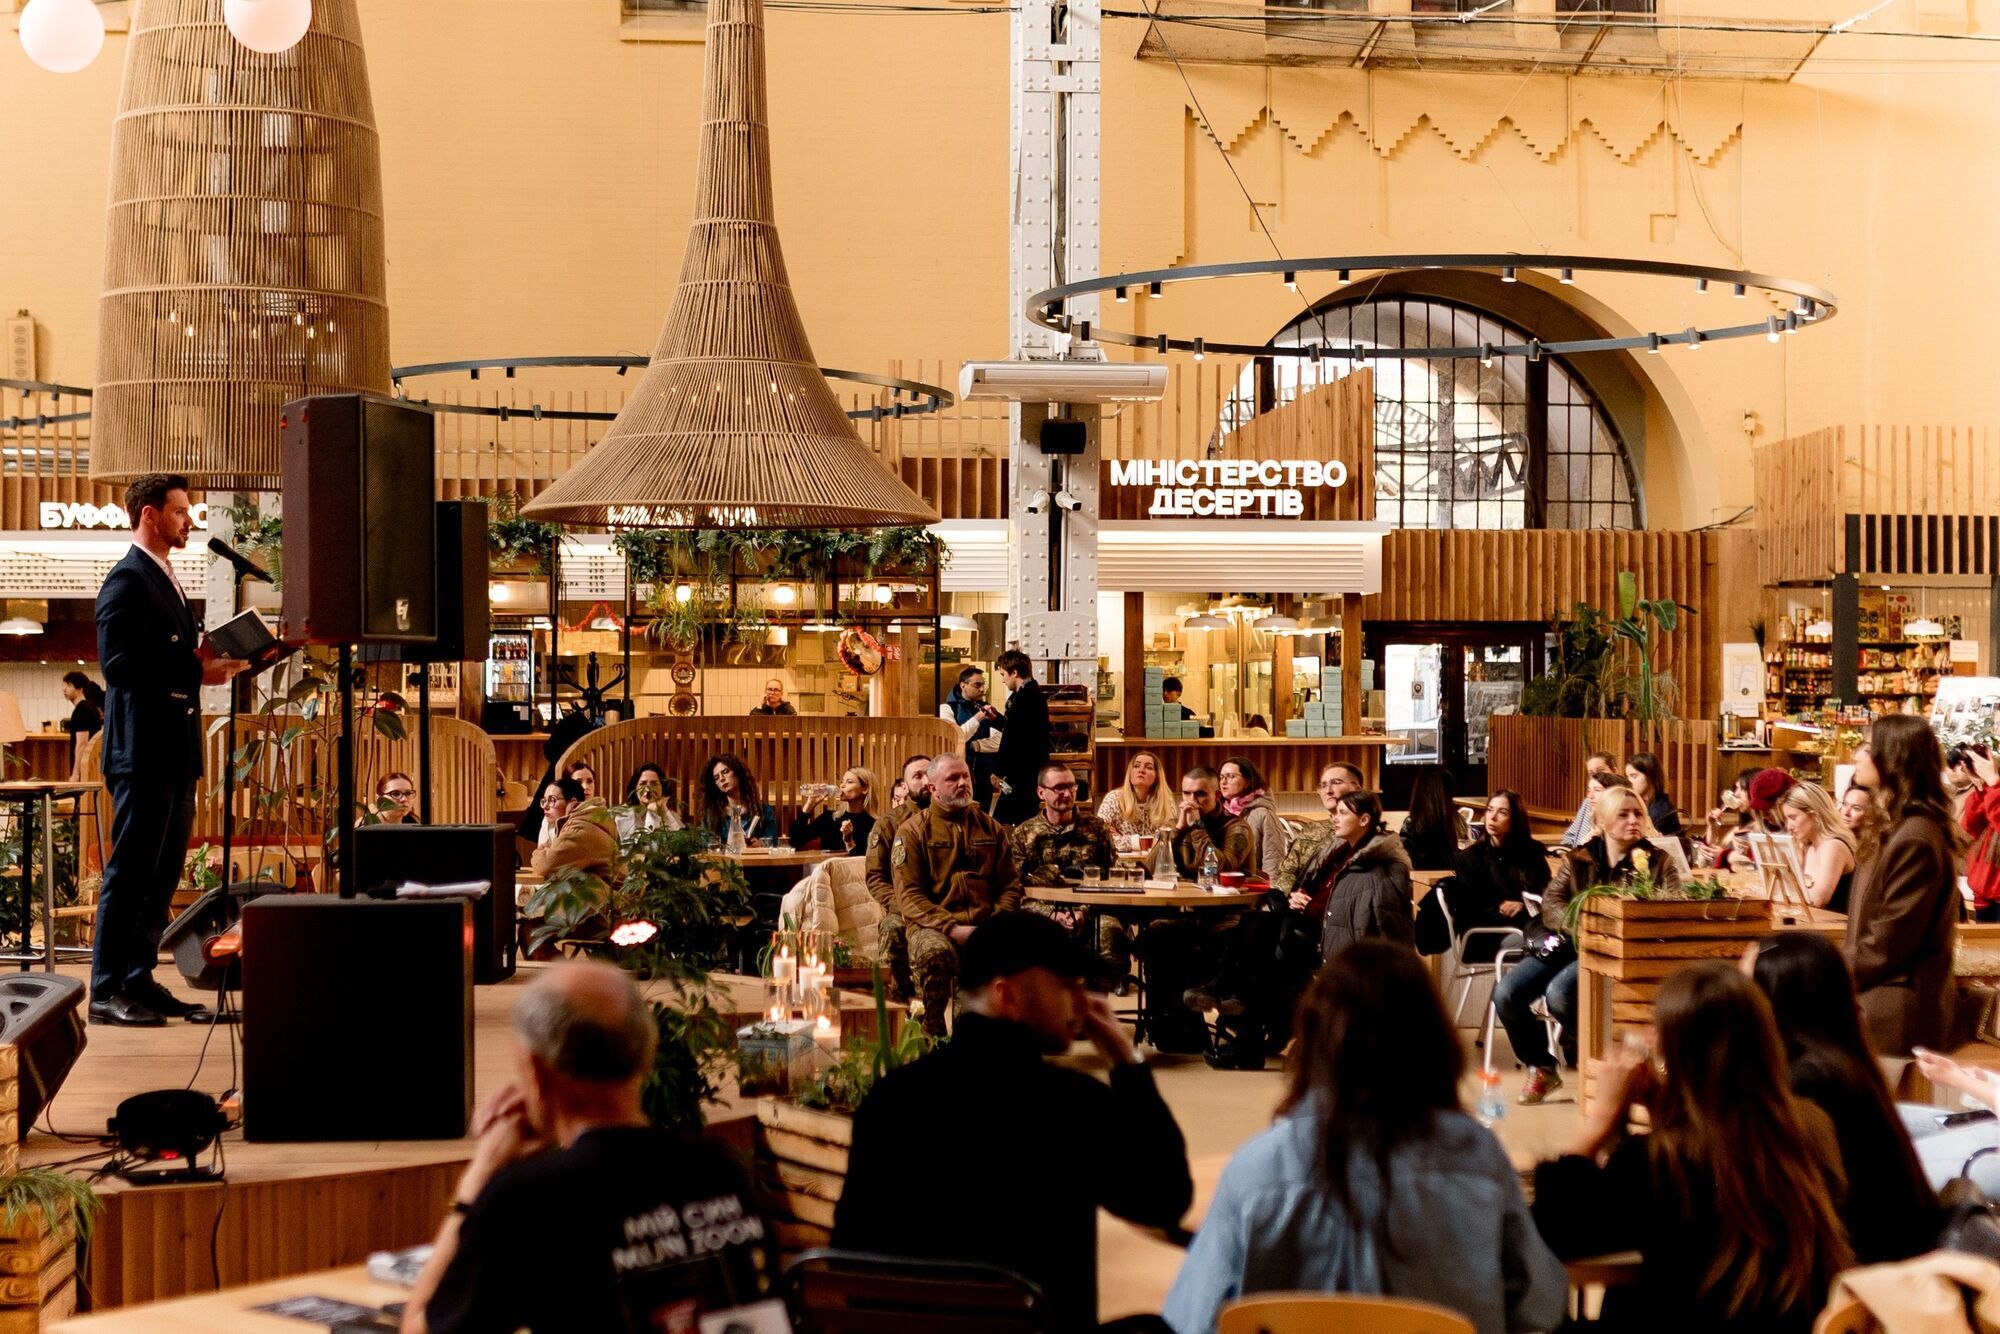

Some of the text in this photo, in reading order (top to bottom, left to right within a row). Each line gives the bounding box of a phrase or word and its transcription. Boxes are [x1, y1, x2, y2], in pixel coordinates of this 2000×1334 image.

[1110, 459, 1347, 487] МІНІСТЕРСТВО
[1148, 488, 1304, 516] ДЕСЕРТІВ
[682, 1195, 743, 1229] СИН
